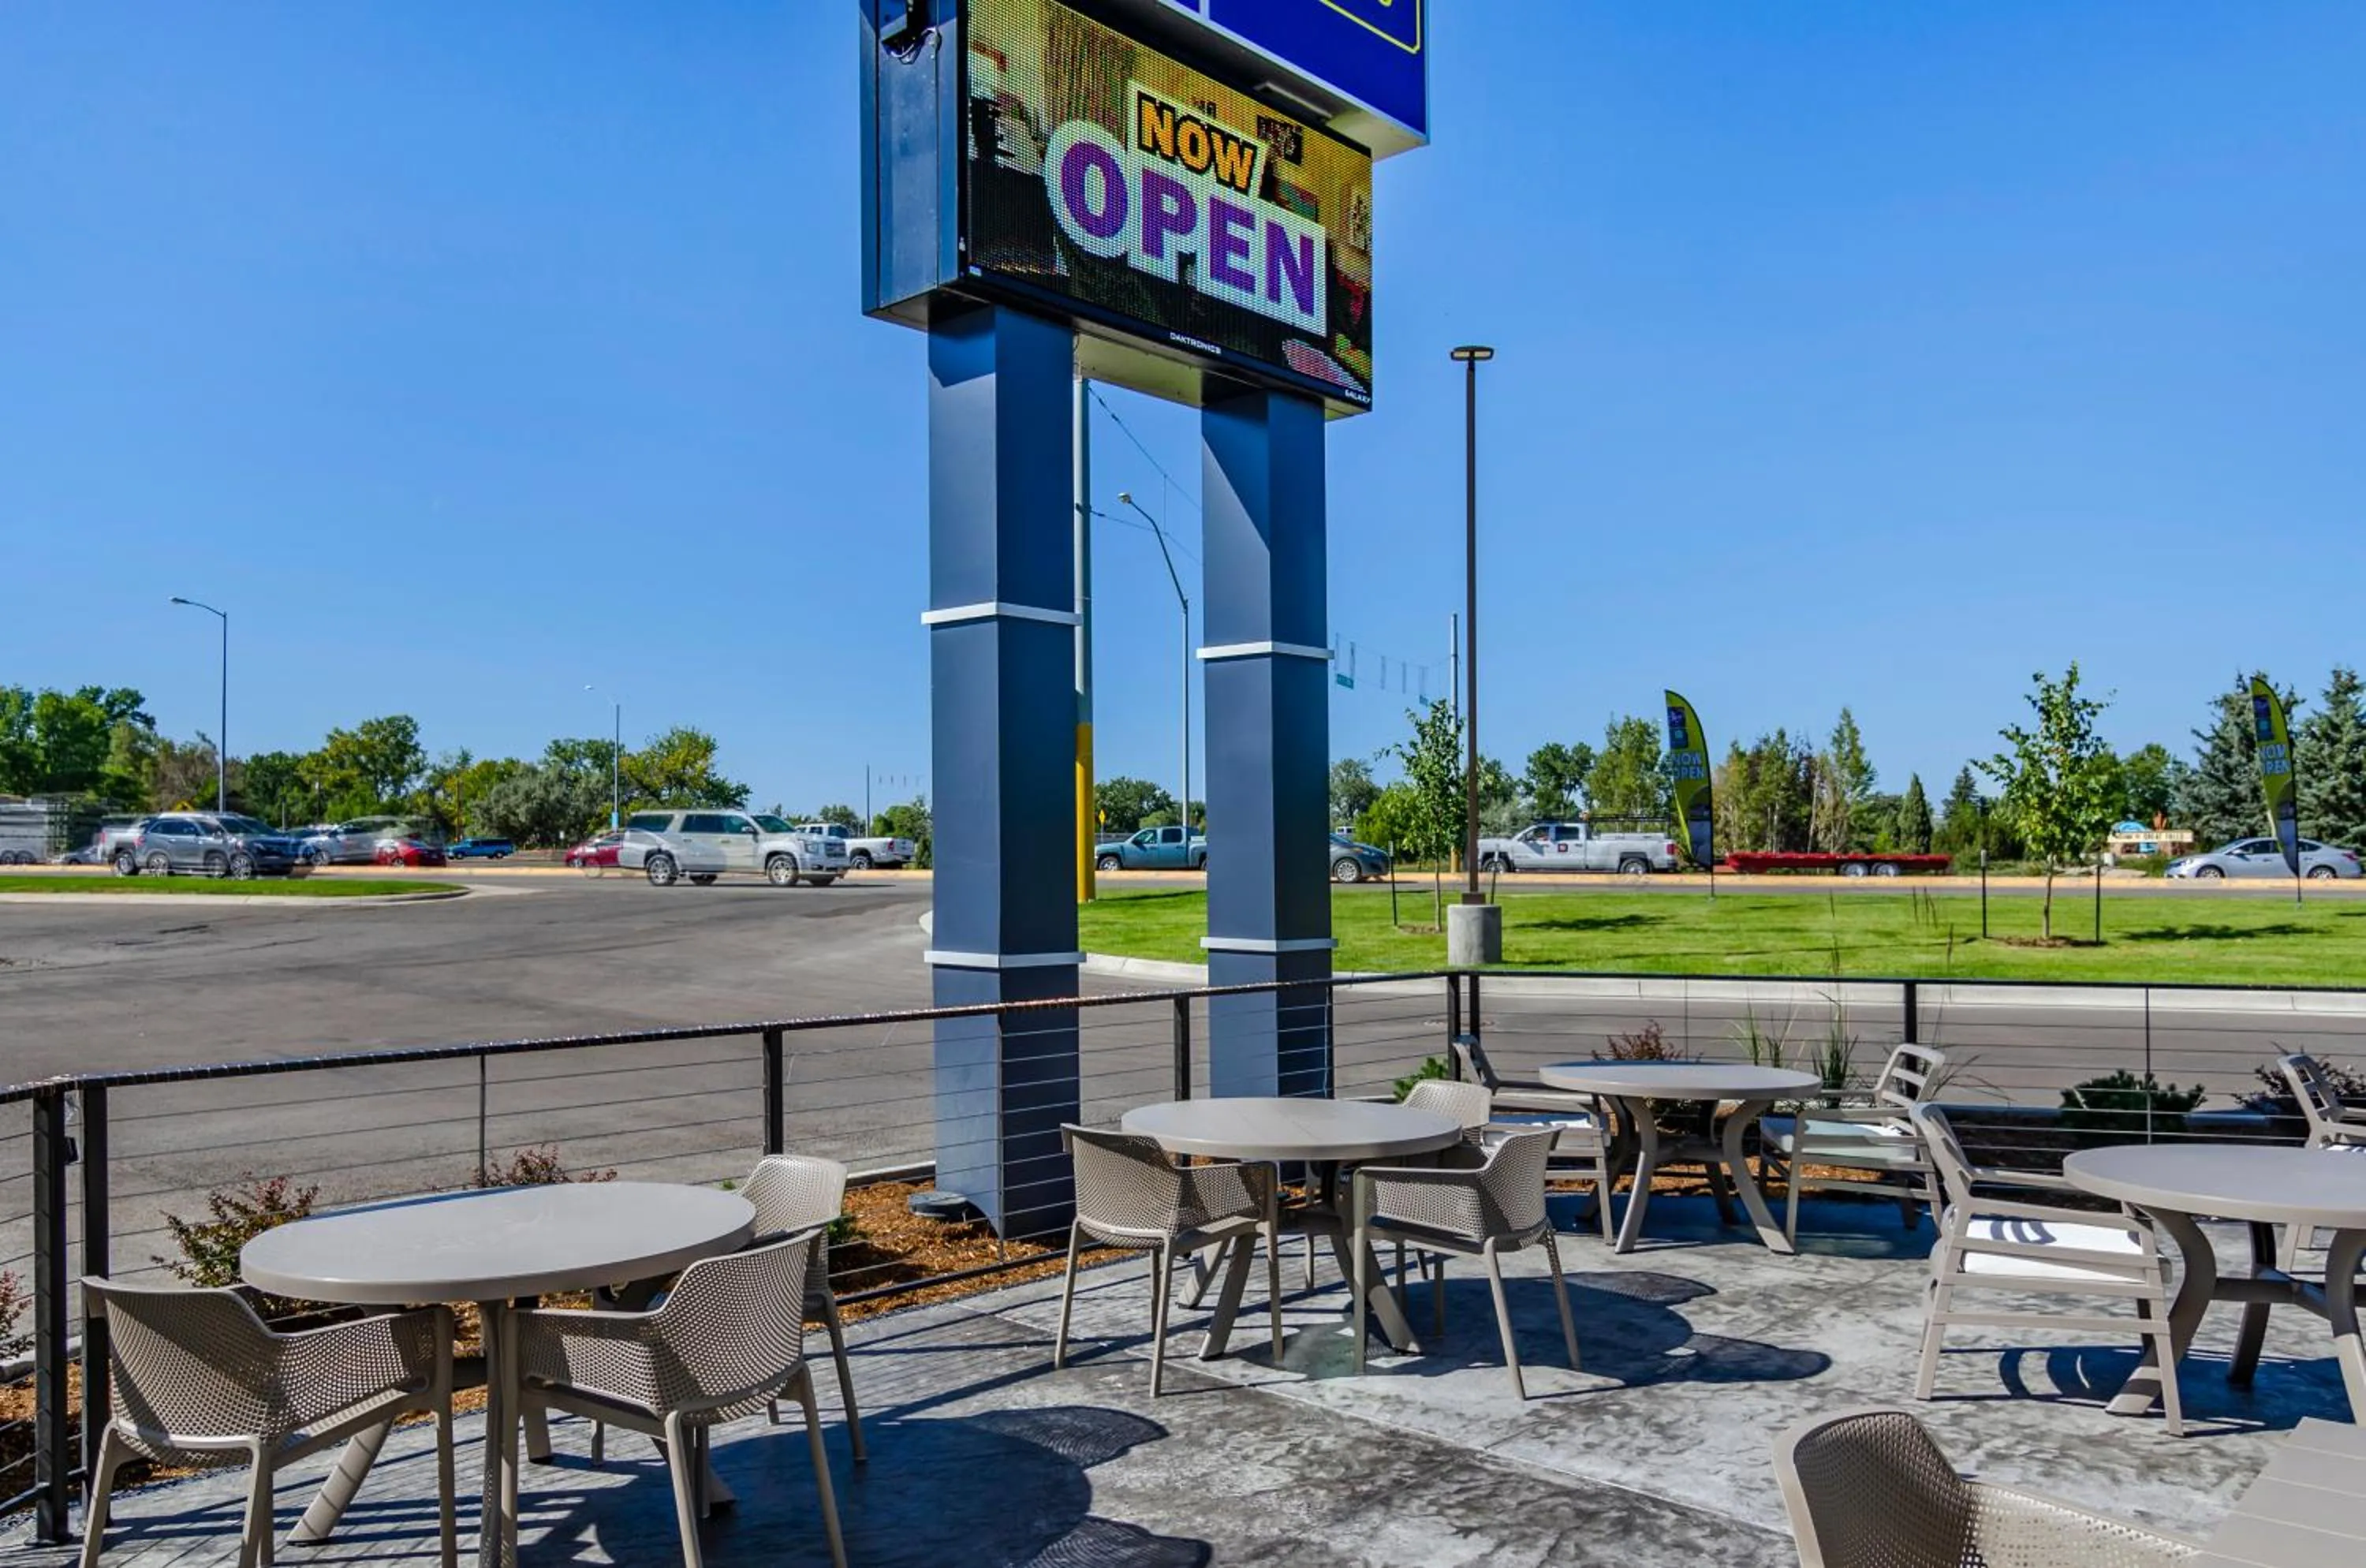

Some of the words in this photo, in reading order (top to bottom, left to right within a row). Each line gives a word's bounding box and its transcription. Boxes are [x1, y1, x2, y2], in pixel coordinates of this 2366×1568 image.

[1140, 99, 1254, 189] NOW
[1060, 139, 1315, 317] OPEN
[1170, 332, 1222, 355] DAKTRONICS
